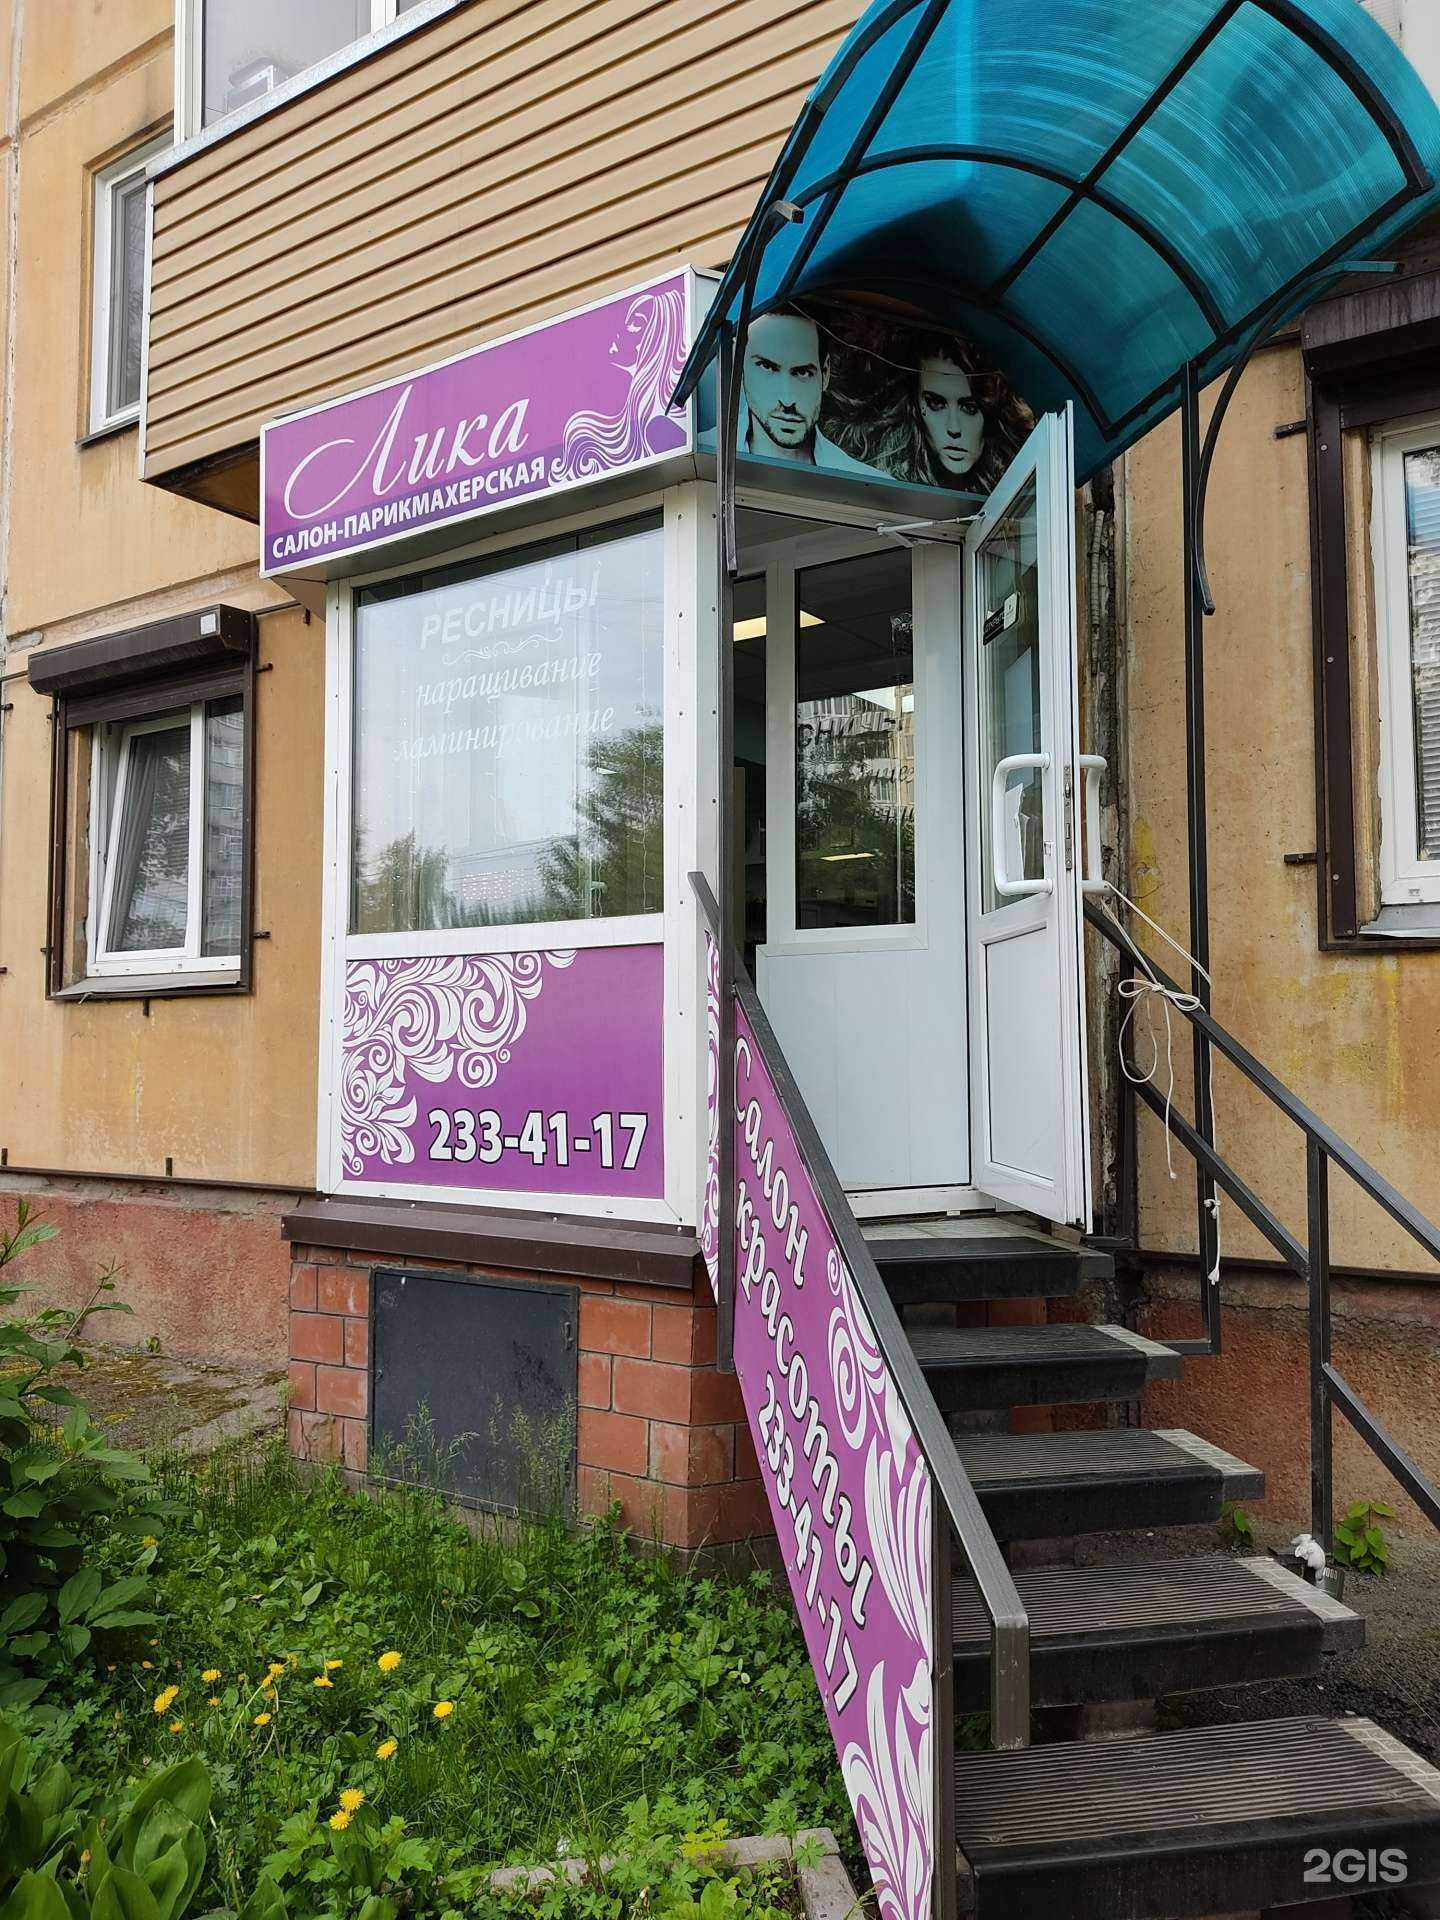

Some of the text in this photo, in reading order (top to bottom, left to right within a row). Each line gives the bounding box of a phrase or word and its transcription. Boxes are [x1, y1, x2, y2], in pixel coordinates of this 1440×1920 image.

[272, 456, 546, 559] САЛОН-ПАРИКМАХЕРСКАЯ
[284, 384, 530, 520] Лика
[420, 568, 600, 650] РЕСНИЦЫ
[416, 652, 603, 714] наращивание
[427, 1107, 649, 1171] 233-41-17
[733, 1035, 809, 1287] Салон
[735, 1181, 873, 1630] красоты
[757, 1370, 859, 1717] 233-41-17
